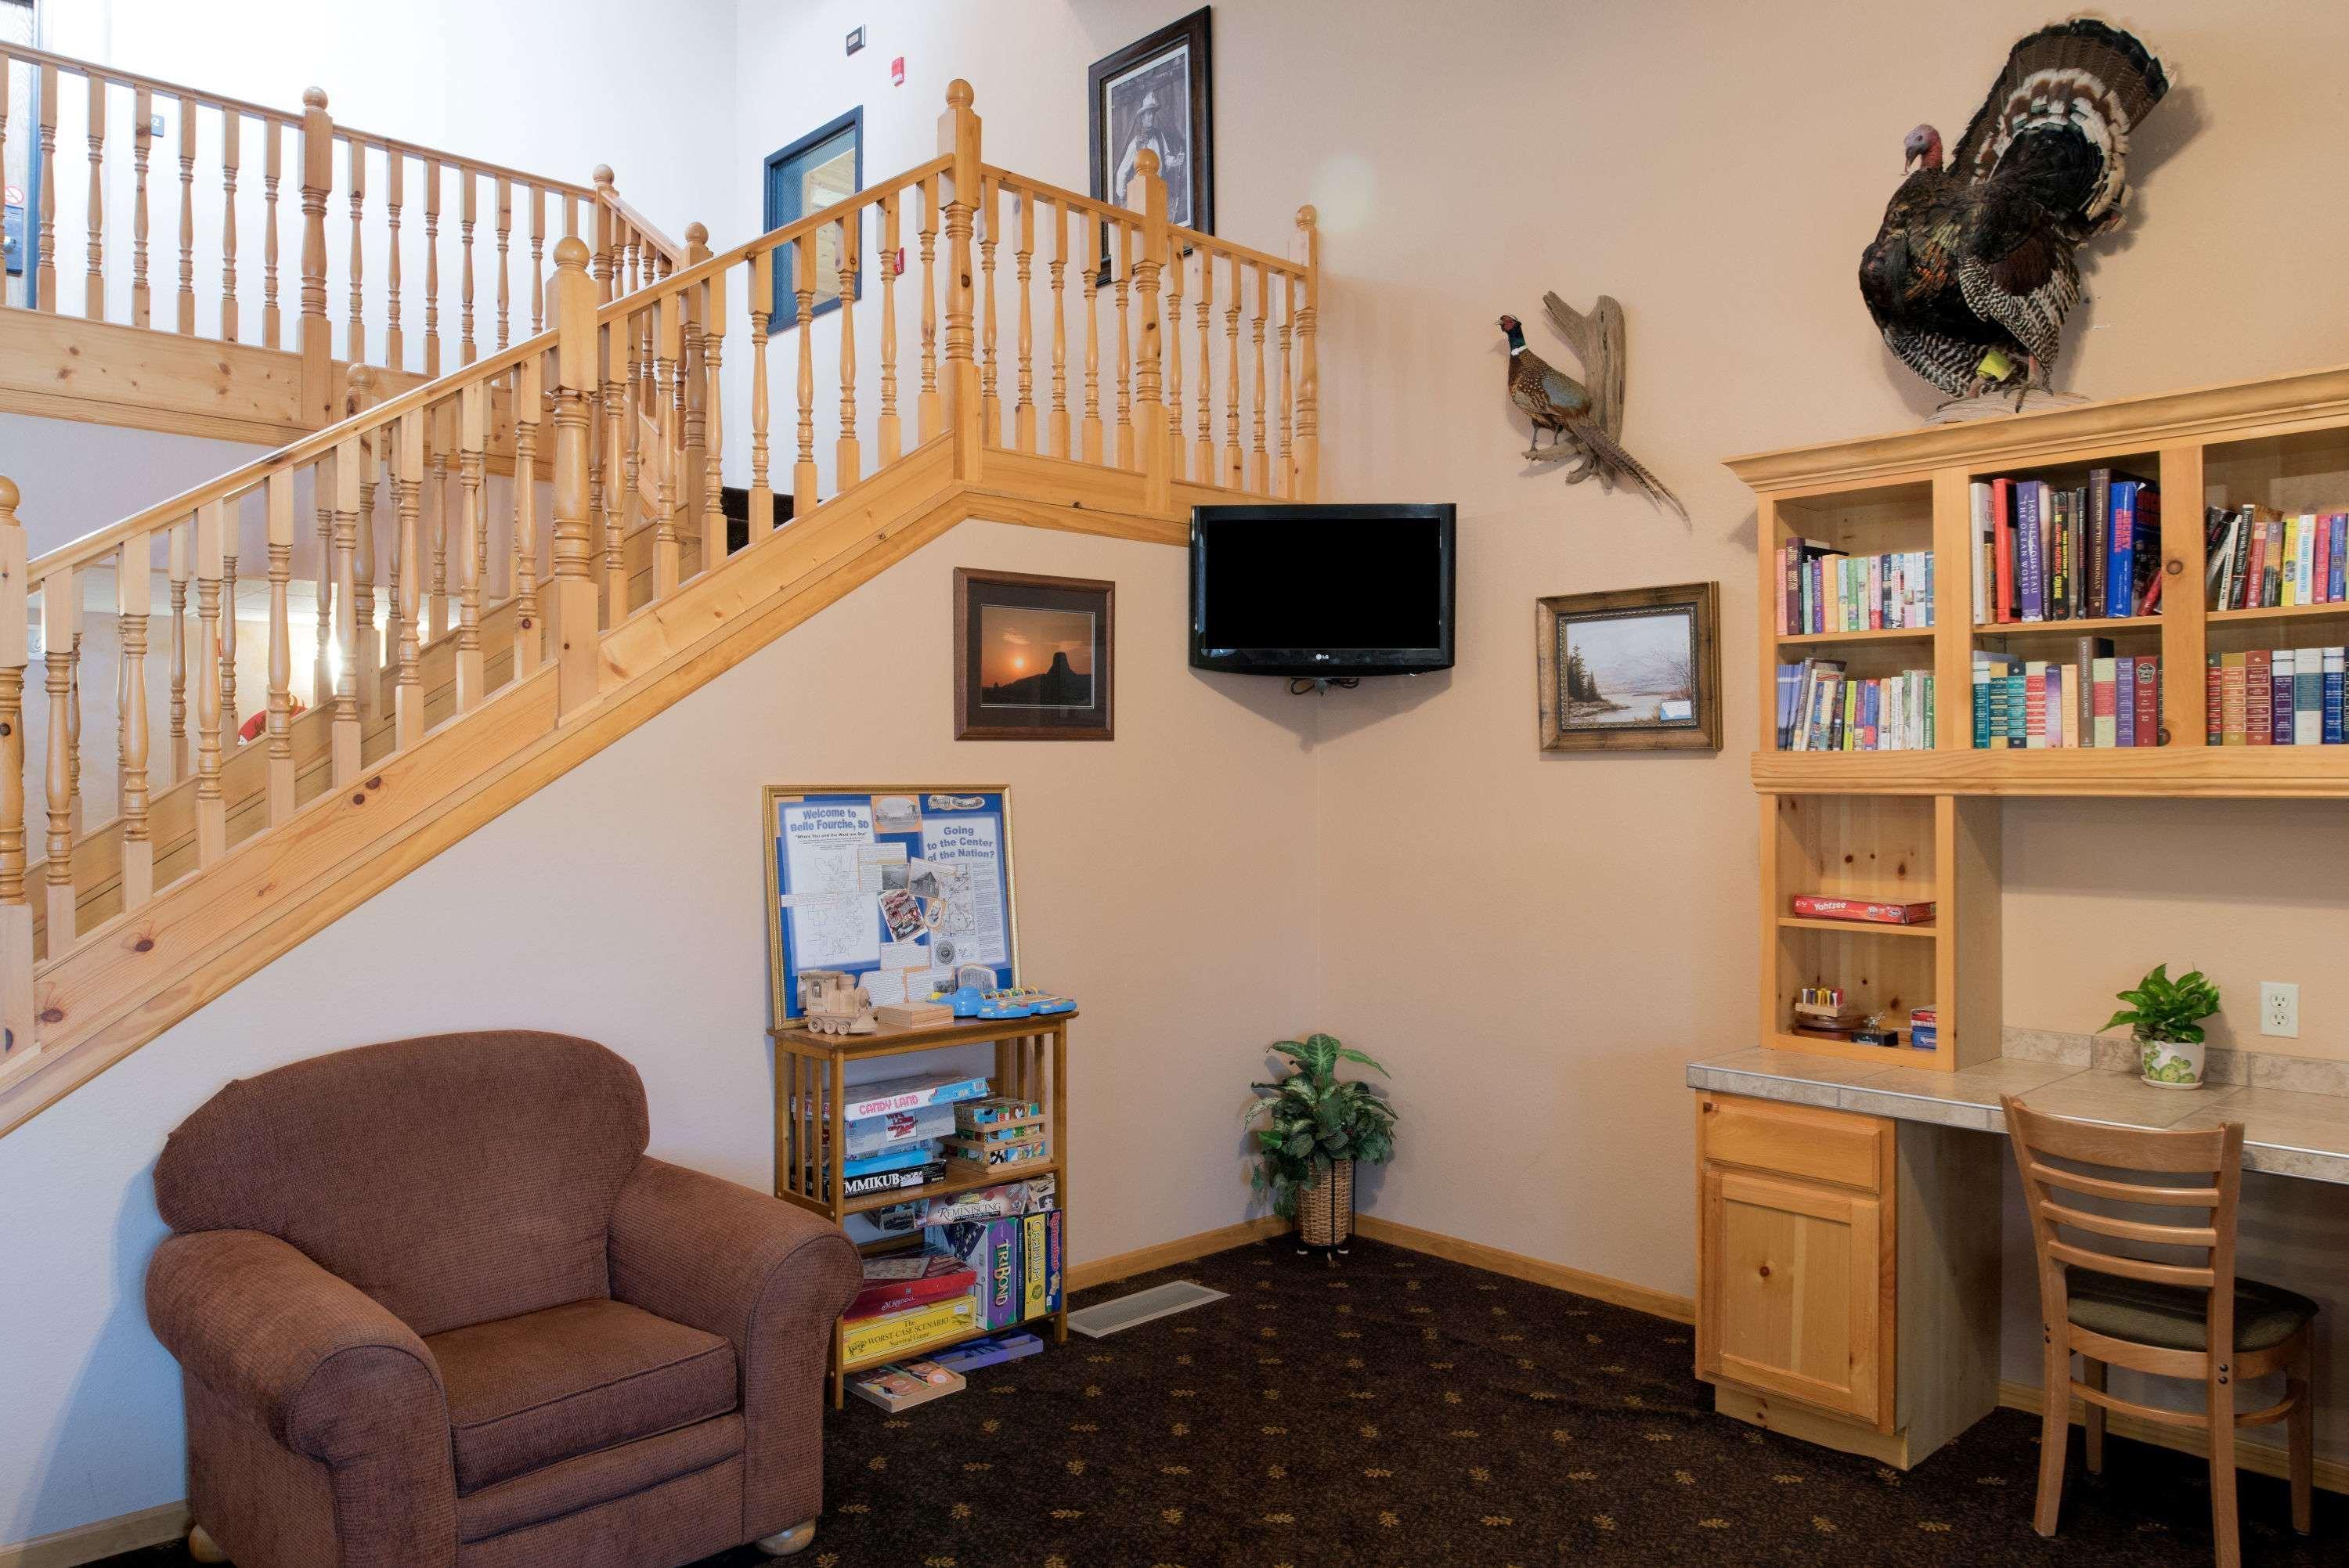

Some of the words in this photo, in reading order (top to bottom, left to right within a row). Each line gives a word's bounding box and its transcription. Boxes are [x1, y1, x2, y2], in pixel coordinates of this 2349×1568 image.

[803, 808, 845, 820] Welcome
[848, 807, 857, 818] to
[790, 820, 814, 831] Belle
[817, 820, 856, 831] Fourche,
[858, 820, 869, 828] SD
[944, 826, 974, 836] Going
[940, 838, 956, 848] the
[959, 837, 994, 847] Center
[928, 852, 937, 862] of
[940, 850, 956, 860] the
[958, 849, 995, 859] Nation?
[1814, 902, 1847, 911] Yahtzee
[859, 1099, 892, 1116] CANDY
[894, 1094, 918, 1108] LAND
[844, 1173, 900, 1195] MMIKUB
[939, 1202, 1001, 1222] REMINISCING
[904, 1319, 915, 1328] The
[868, 1328, 913, 1345] WORST-CASE
[915, 1317, 949, 1332] SCENARIO
[889, 1334, 912, 1347] Survival
[913, 1332, 929, 1342] Game
